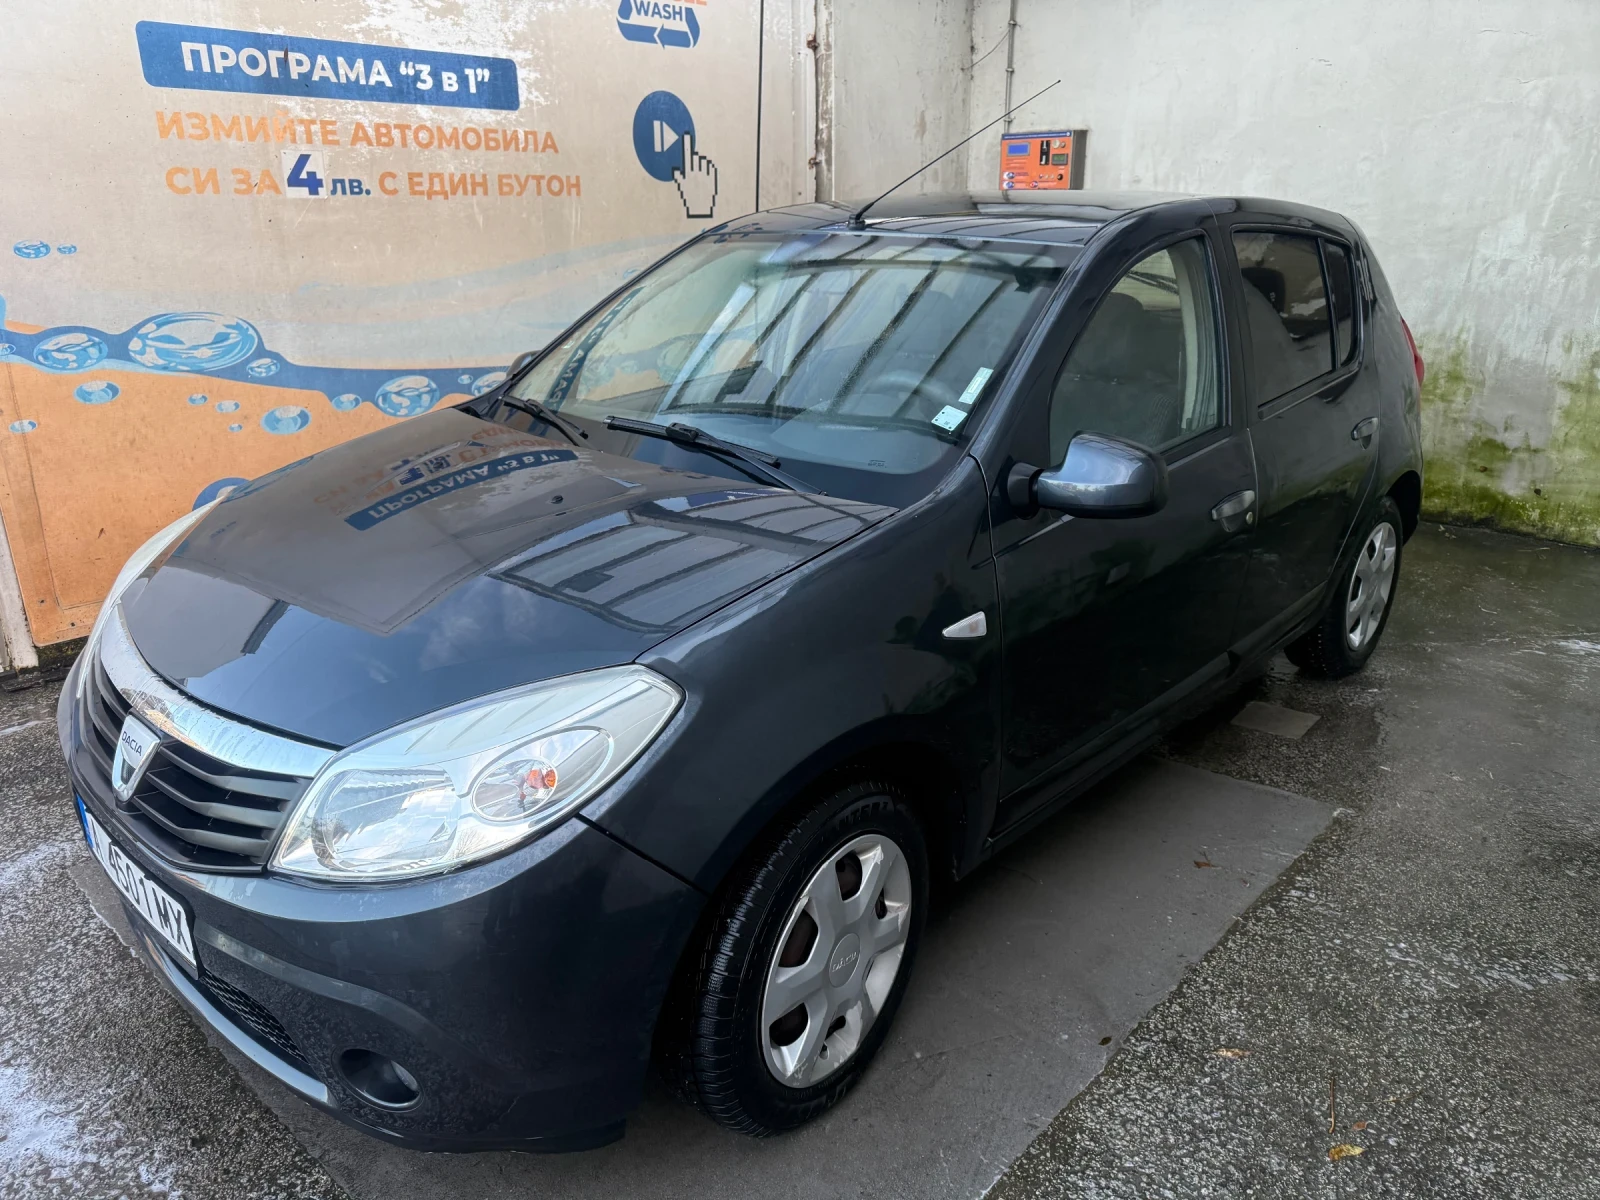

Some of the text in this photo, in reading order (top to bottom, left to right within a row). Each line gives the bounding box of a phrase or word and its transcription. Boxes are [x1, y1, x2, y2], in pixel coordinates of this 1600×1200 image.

[633, 0, 684, 21] WASH
[181, 41, 393, 87] ПРОГРАМА
[441, 71, 459, 92] в
[156, 110, 560, 154] ИЗМИЙТЕ АВТОМОБИЛА
[165, 166, 221, 195] СИ
[231, 168, 283, 195] ЗА
[286, 153, 324, 196] 4
[378, 171, 400, 196] С
[407, 171, 489, 201] ЕДИН
[497, 173, 582, 197] БУТОН
[121, 730, 143, 757] DACIA
[108, 841, 153, 920] 4501
[152, 887, 192, 955] MX
